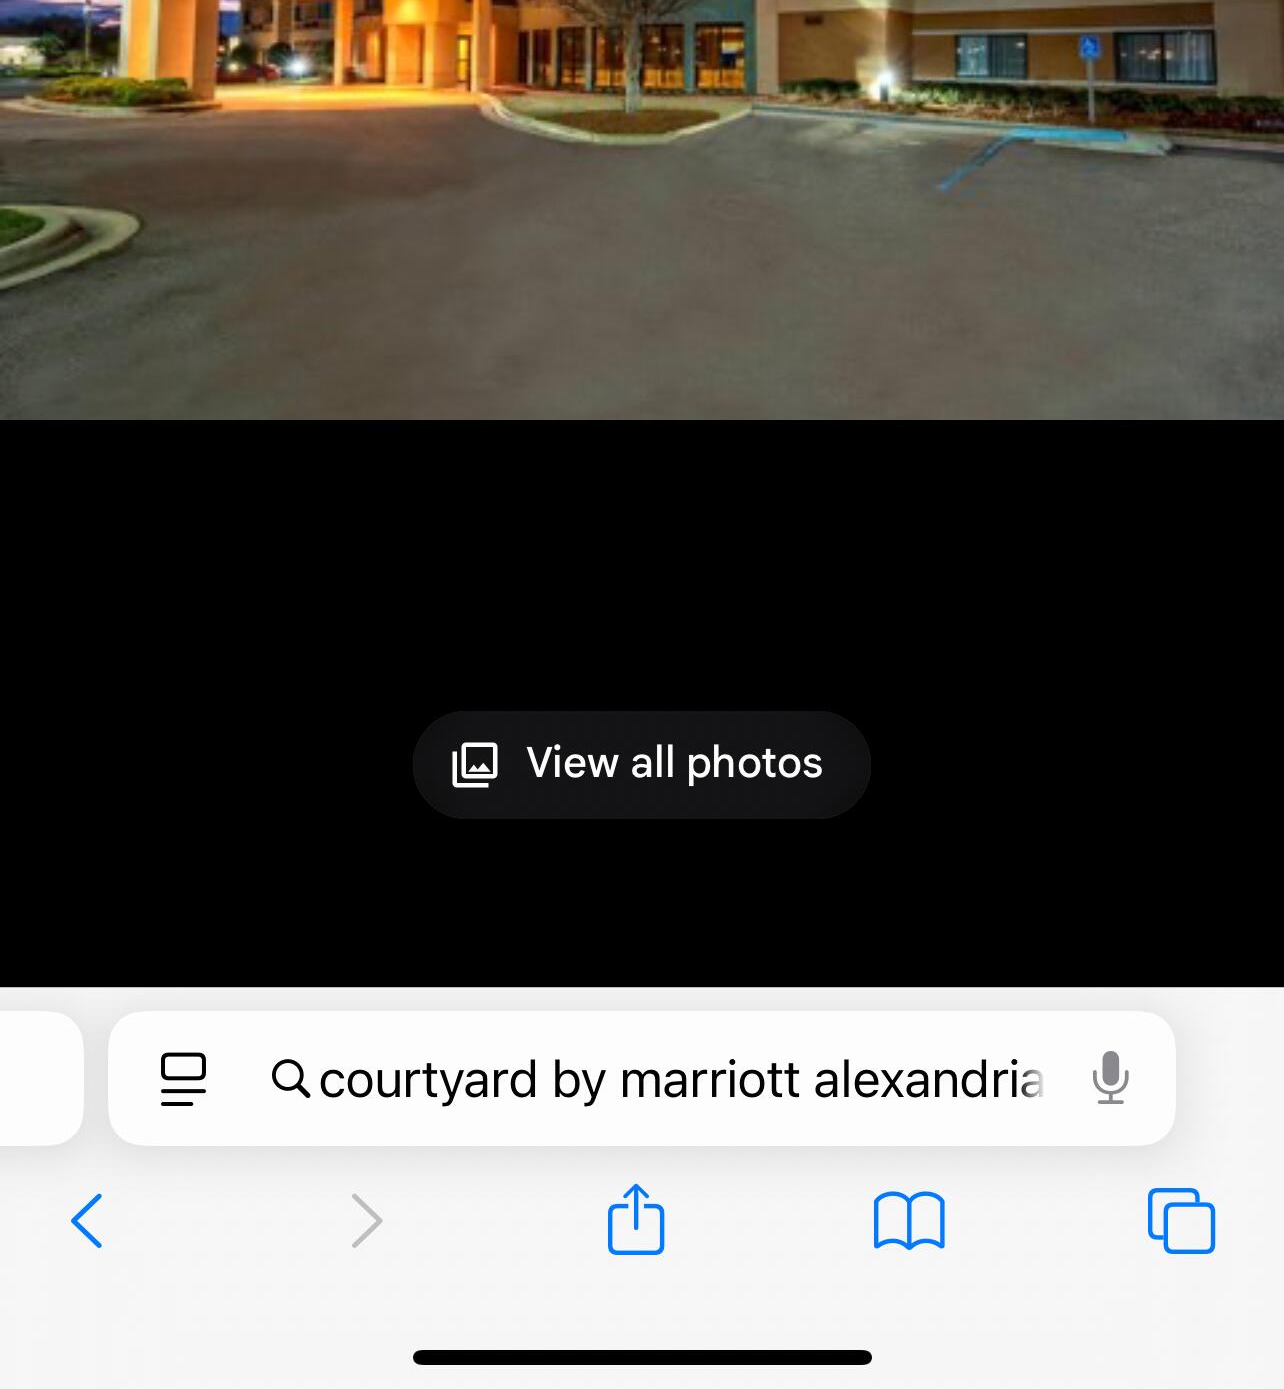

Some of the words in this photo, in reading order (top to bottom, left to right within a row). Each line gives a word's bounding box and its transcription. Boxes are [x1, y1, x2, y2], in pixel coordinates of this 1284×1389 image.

[526, 743, 620, 779] View
[631, 743, 674, 779] all
[688, 743, 823, 787] photos
[319, 1058, 536, 1108] courtyard
[554, 1058, 607, 1108] by
[622, 1058, 800, 1099] marriott
[814, 1058, 1044, 1099] alexandria
